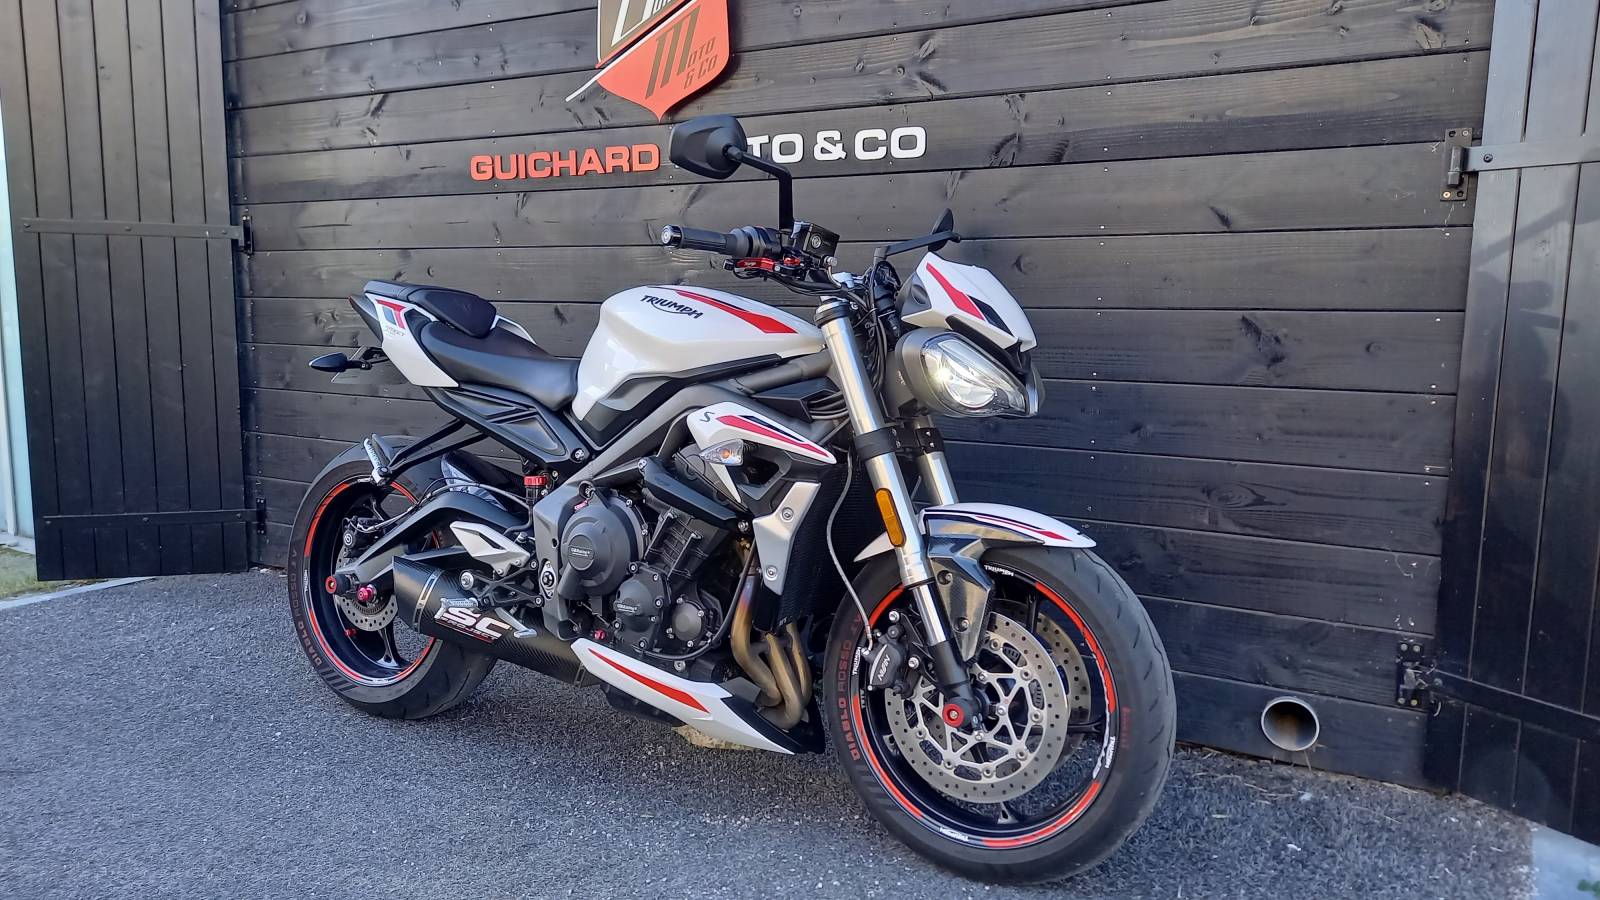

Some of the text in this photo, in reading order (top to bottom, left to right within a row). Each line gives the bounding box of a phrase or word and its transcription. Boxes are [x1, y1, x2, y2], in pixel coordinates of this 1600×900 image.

[470, 126, 926, 181] GUICHARD TO & CO
[640, 295, 703, 319] TRIUMPH
[290, 573, 301, 617] ROSSO
[298, 621, 322, 666] DIABLO
[442, 607, 510, 638] SC
[838, 640, 853, 692] ROSSO
[838, 697, 860, 761] DIABLO
